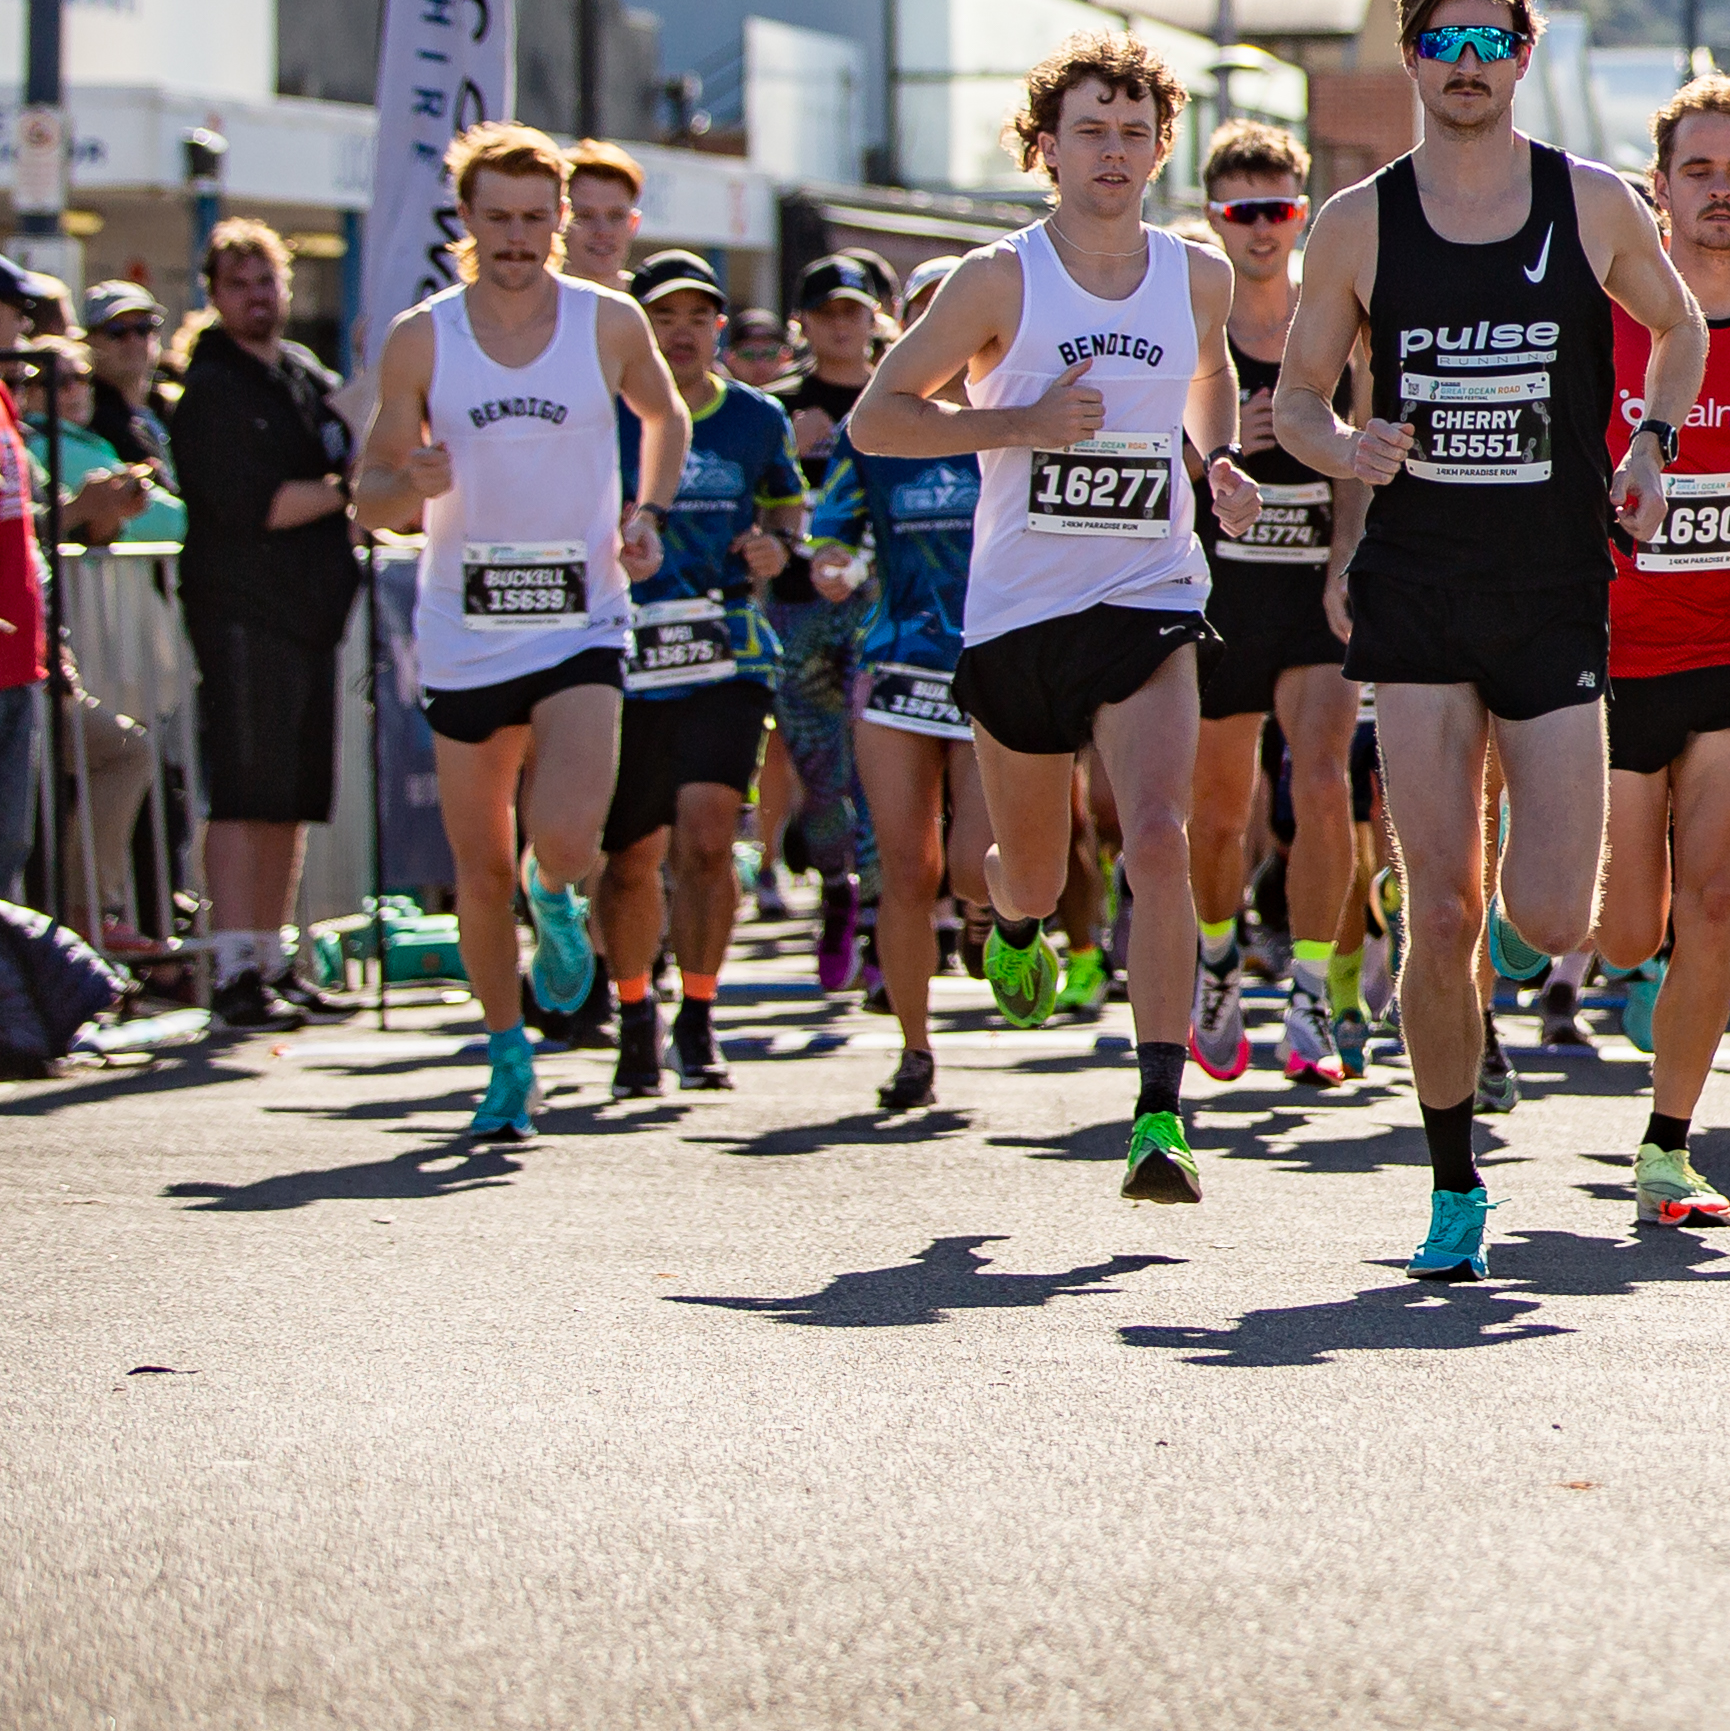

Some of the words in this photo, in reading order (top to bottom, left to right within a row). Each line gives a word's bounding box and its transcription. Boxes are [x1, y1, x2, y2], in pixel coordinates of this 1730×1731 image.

[1400, 321, 1560, 358] pulse
[1058, 333, 1164, 367] BENDIGO
[1439, 352, 1556, 366] RUNNING
[1440, 387, 1467, 395] GREAT
[1468, 387, 1496, 395] OCEAN
[1497, 385, 1521, 395] ROAD
[468, 396, 570, 429] BENDIGO
[1431, 409, 1522, 430] CHERRY
[1101, 441, 1126, 450] OCEAN
[1127, 442, 1148, 450] ROAD
[1431, 433, 1522, 458] 15551
[1436, 467, 1459, 476] 14KM
[1459, 468, 1499, 476] PARADISE
[1500, 468, 1518, 476] RUN
[1037, 464, 1168, 509] 16277
[1062, 520, 1083, 530] 14KM
[1084, 521, 1121, 531] PARADISE
[1122, 522, 1139, 532] RUN
[1669, 557, 1690, 566] 14KM
[1690, 556, 1724, 564] PARADISE
[483, 568, 568, 588] BUCKELL
[487, 589, 566, 611] 15639
[658, 625, 693, 643] WEI
[643, 640, 714, 668] 15675
